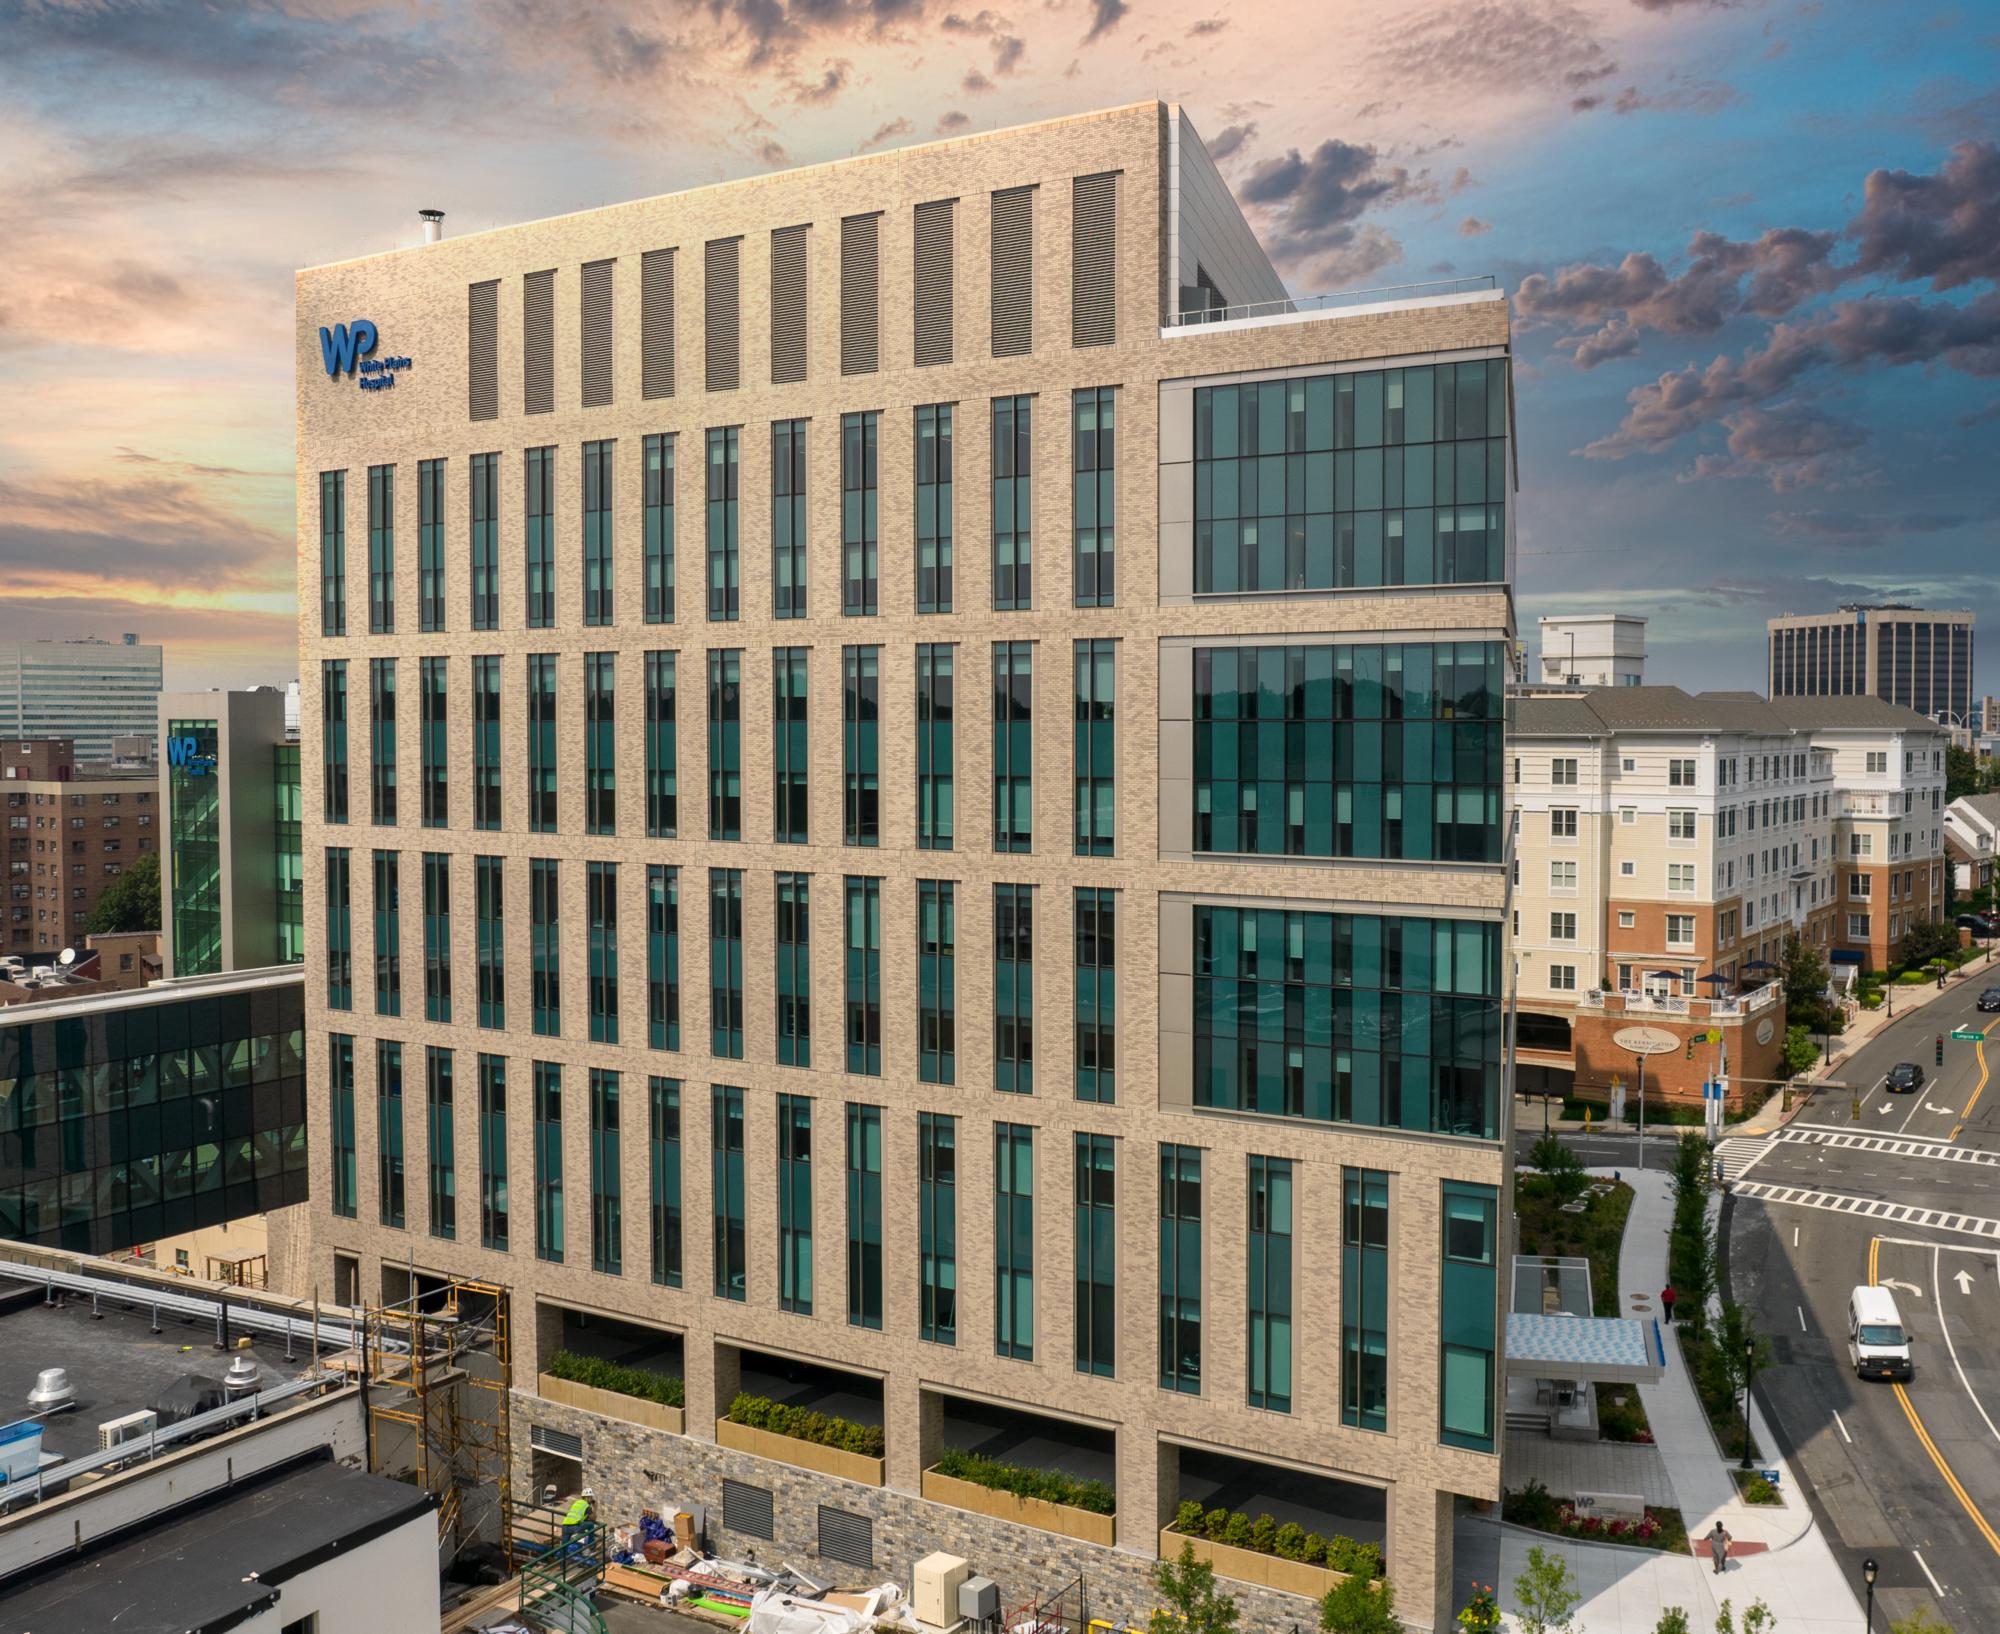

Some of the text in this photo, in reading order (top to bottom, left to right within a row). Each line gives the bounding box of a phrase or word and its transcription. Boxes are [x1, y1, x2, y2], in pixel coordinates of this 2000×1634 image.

[319, 320, 378, 376] WP
[360, 356, 411, 374] White Plains
[360, 374, 394, 390] Hospital
[168, 736, 197, 768] WP
[1577, 1497, 1595, 1508] WP
